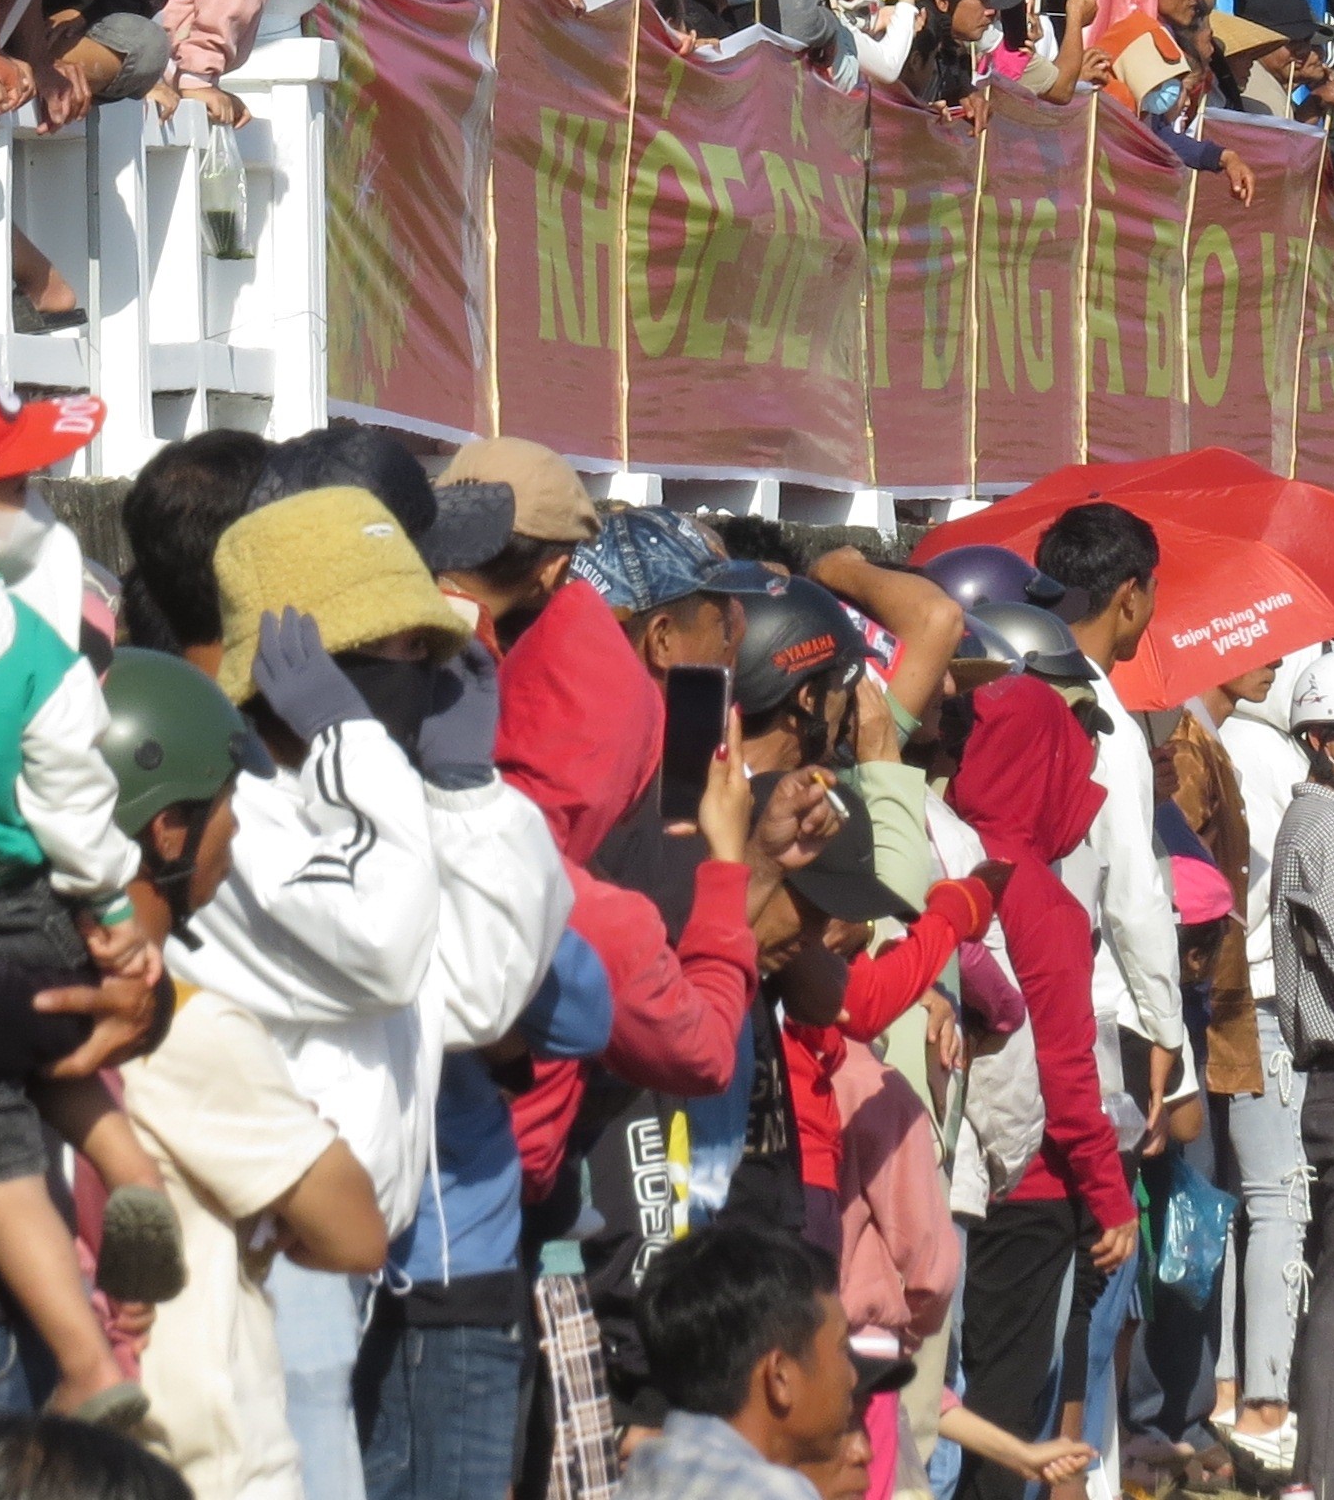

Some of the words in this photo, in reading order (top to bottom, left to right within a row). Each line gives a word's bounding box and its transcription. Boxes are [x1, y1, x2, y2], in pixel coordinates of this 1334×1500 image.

[1171, 625, 1212, 649] Enjoy
[1210, 608, 1256, 633] Flying
[1253, 592, 1294, 615] With
[785, 633, 836, 663] YAMAHA
